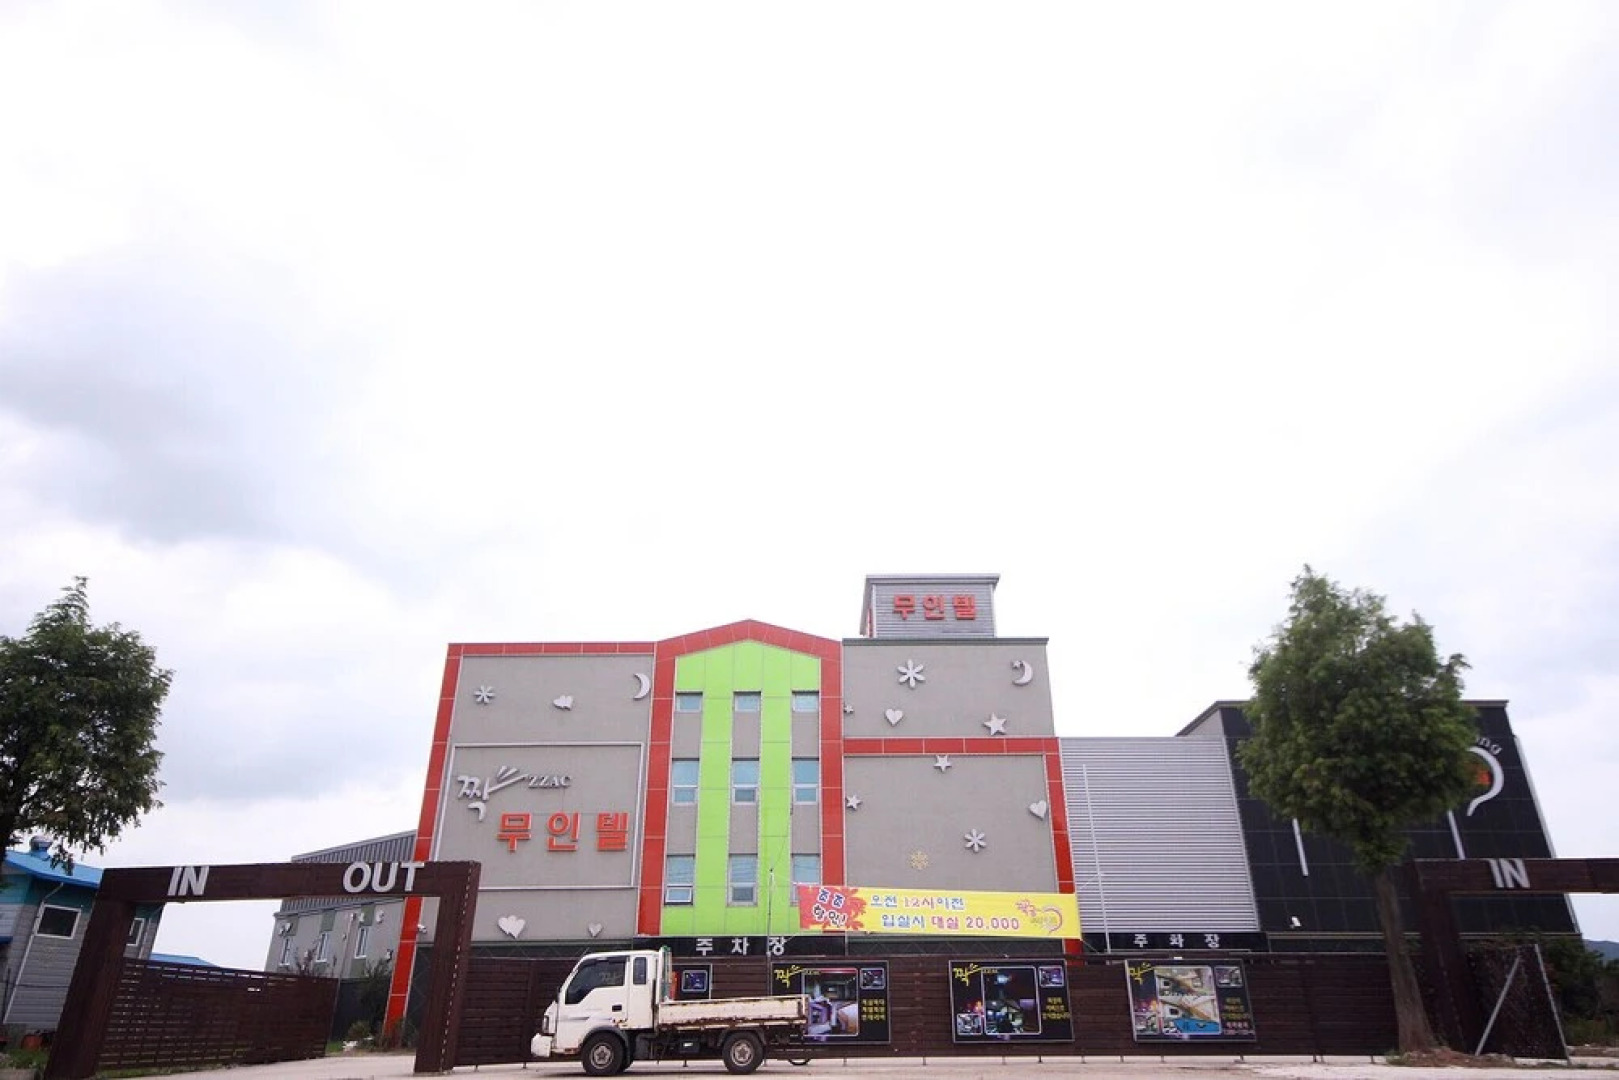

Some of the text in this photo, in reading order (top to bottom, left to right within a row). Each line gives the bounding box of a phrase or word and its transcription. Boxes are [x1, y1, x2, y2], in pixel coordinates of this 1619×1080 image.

[893, 594, 976, 620] 무인텔
[457, 771, 529, 822] 짝
[527, 775, 572, 789] ZZAC
[497, 812, 629, 853] 무인텔
[167, 866, 209, 896] IN
[342, 861, 424, 893] OUT
[1488, 858, 1530, 888] IN
[931, 916, 959, 929] 대실
[696, 937, 785, 955] 주차장
